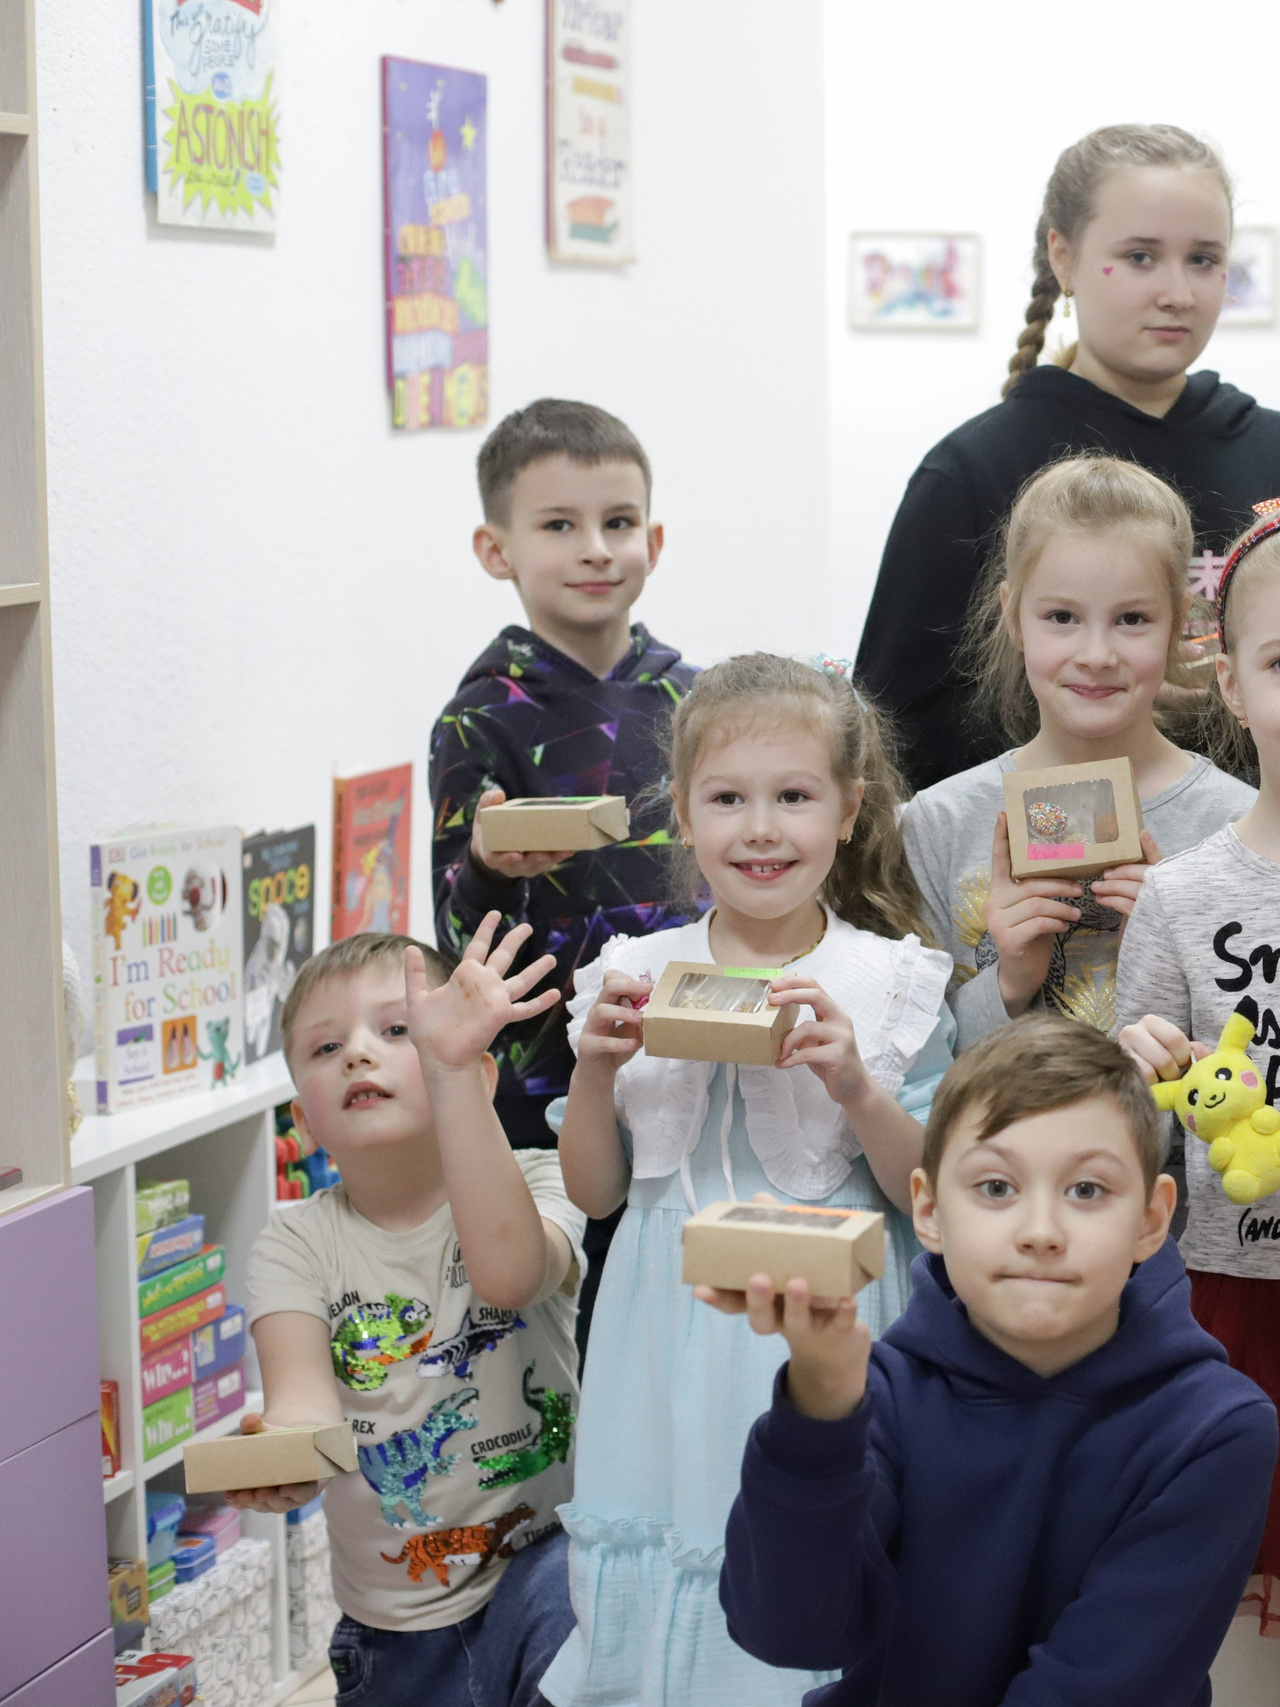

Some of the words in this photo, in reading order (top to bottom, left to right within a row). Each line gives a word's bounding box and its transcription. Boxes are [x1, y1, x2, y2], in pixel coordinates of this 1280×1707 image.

[170, 9, 189, 35] This
[188, 9, 264, 76] gratify
[202, 54, 235, 72] PEOPLE
[203, 39, 231, 54] SOME
[175, 99, 271, 175] ASTONISH
[249, 864, 310, 923] space
[110, 954, 150, 987] I'm
[157, 937, 231, 975] Ready
[123, 990, 156, 1023] for
[162, 970, 237, 1015] School
[350, 1419, 376, 1435] REX
[470, 1423, 534, 1456] CROCODILE
